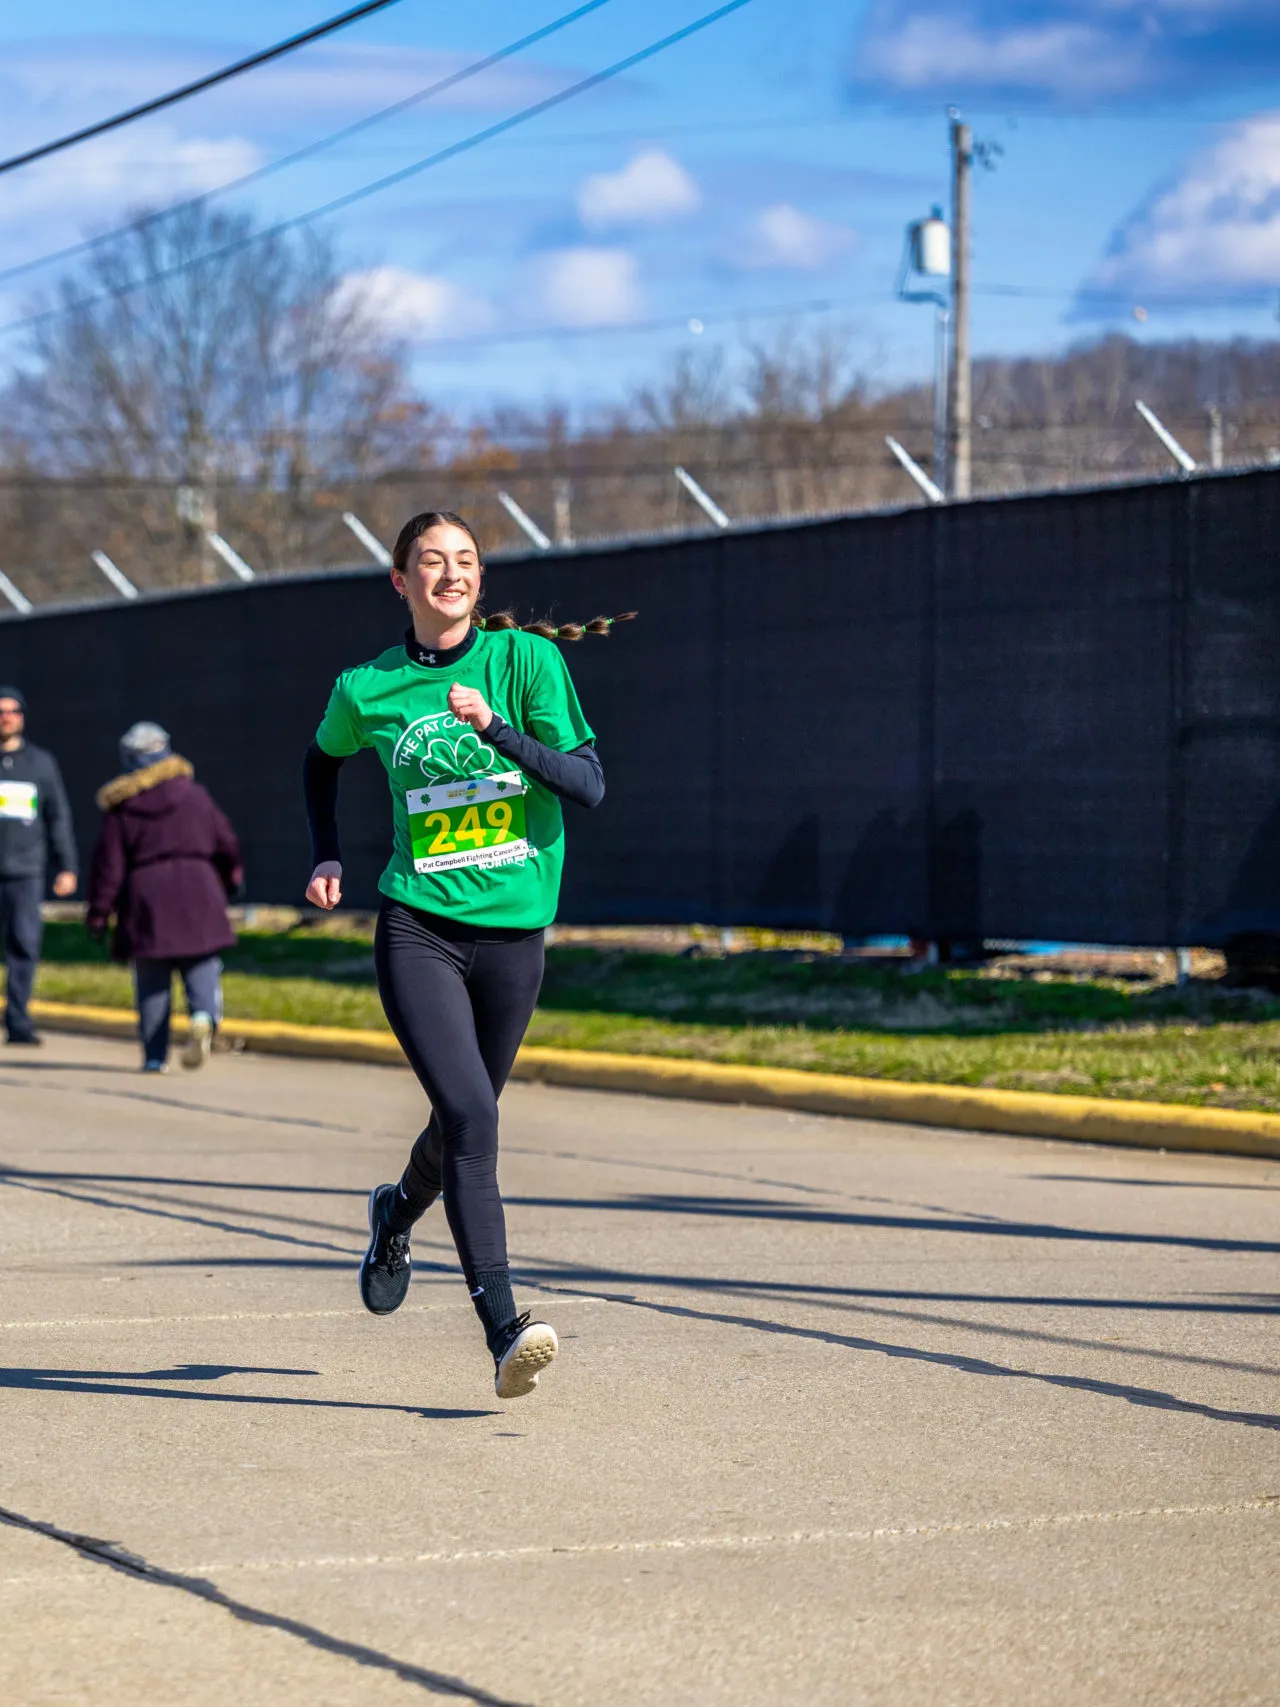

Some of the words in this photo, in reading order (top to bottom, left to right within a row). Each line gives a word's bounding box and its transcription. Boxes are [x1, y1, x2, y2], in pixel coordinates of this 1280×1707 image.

[399, 737, 419, 766] THE
[415, 720, 439, 741] PAT
[425, 801, 512, 855] 249
[422, 861, 434, 869] Pat
[435, 857, 466, 868] Campbell
[466, 851, 493, 862] Fighting
[493, 848, 513, 857] Cancer
